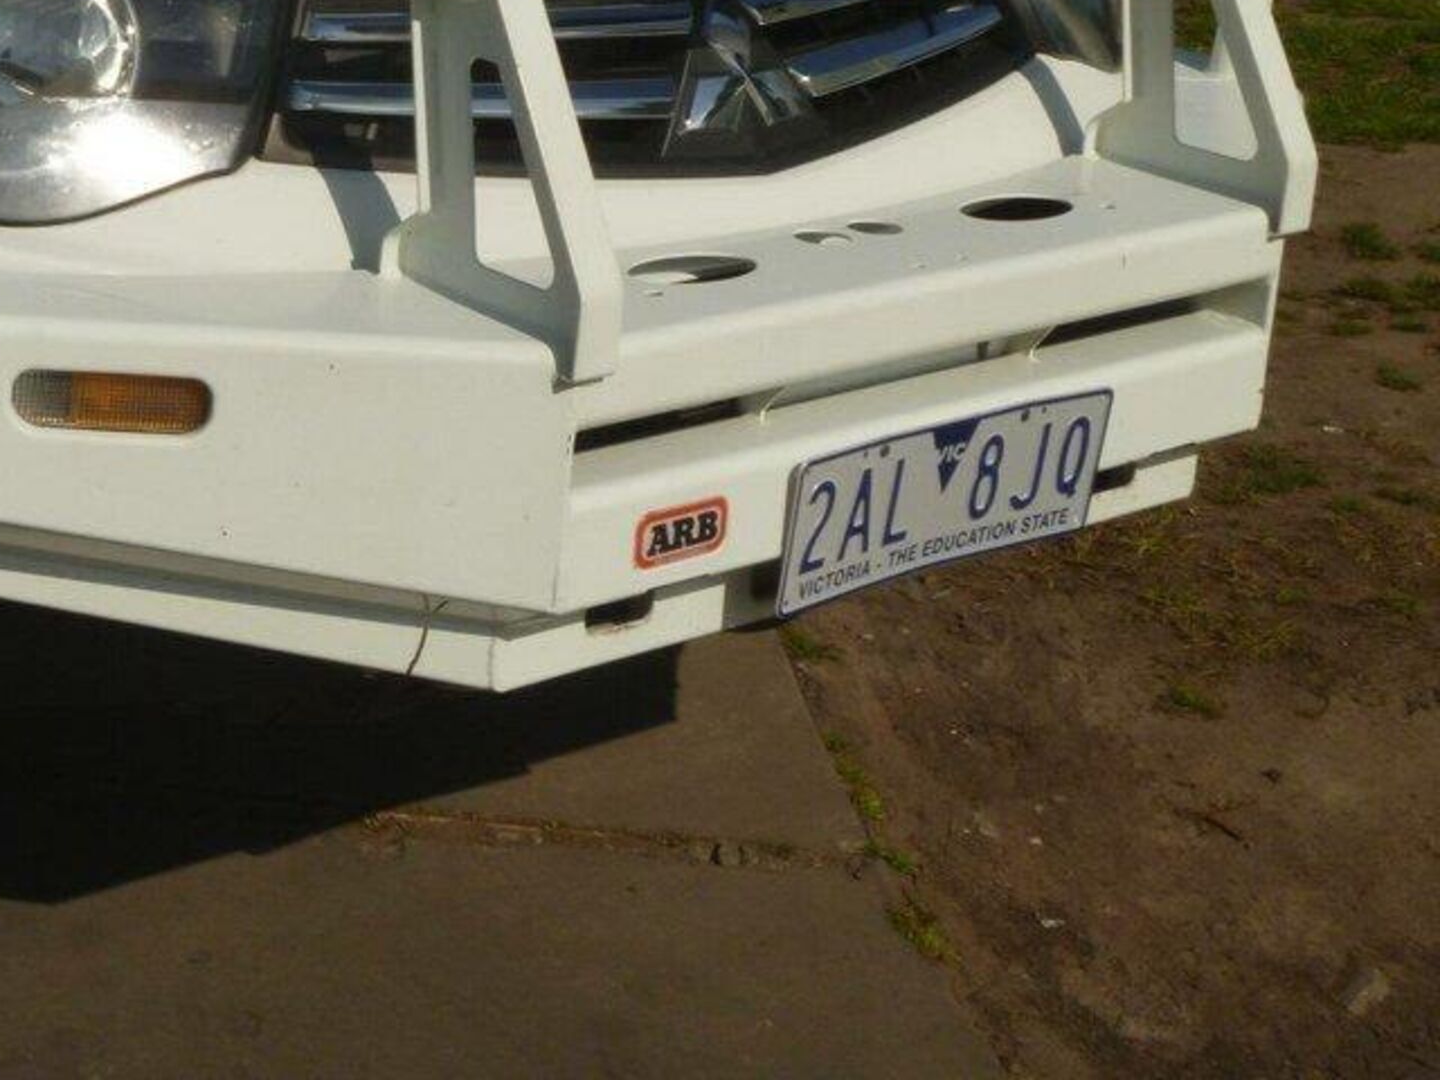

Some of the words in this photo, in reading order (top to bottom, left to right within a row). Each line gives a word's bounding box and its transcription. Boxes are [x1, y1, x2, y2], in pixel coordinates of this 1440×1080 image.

[646, 511, 718, 558] ARB
[799, 458, 908, 575] 2AL
[969, 416, 1090, 519] 8JQ
[798, 560, 871, 600] VICTORIA
[888, 544, 918, 568] THE
[922, 519, 1017, 558] EDUCATION
[1020, 507, 1070, 535] STATE
